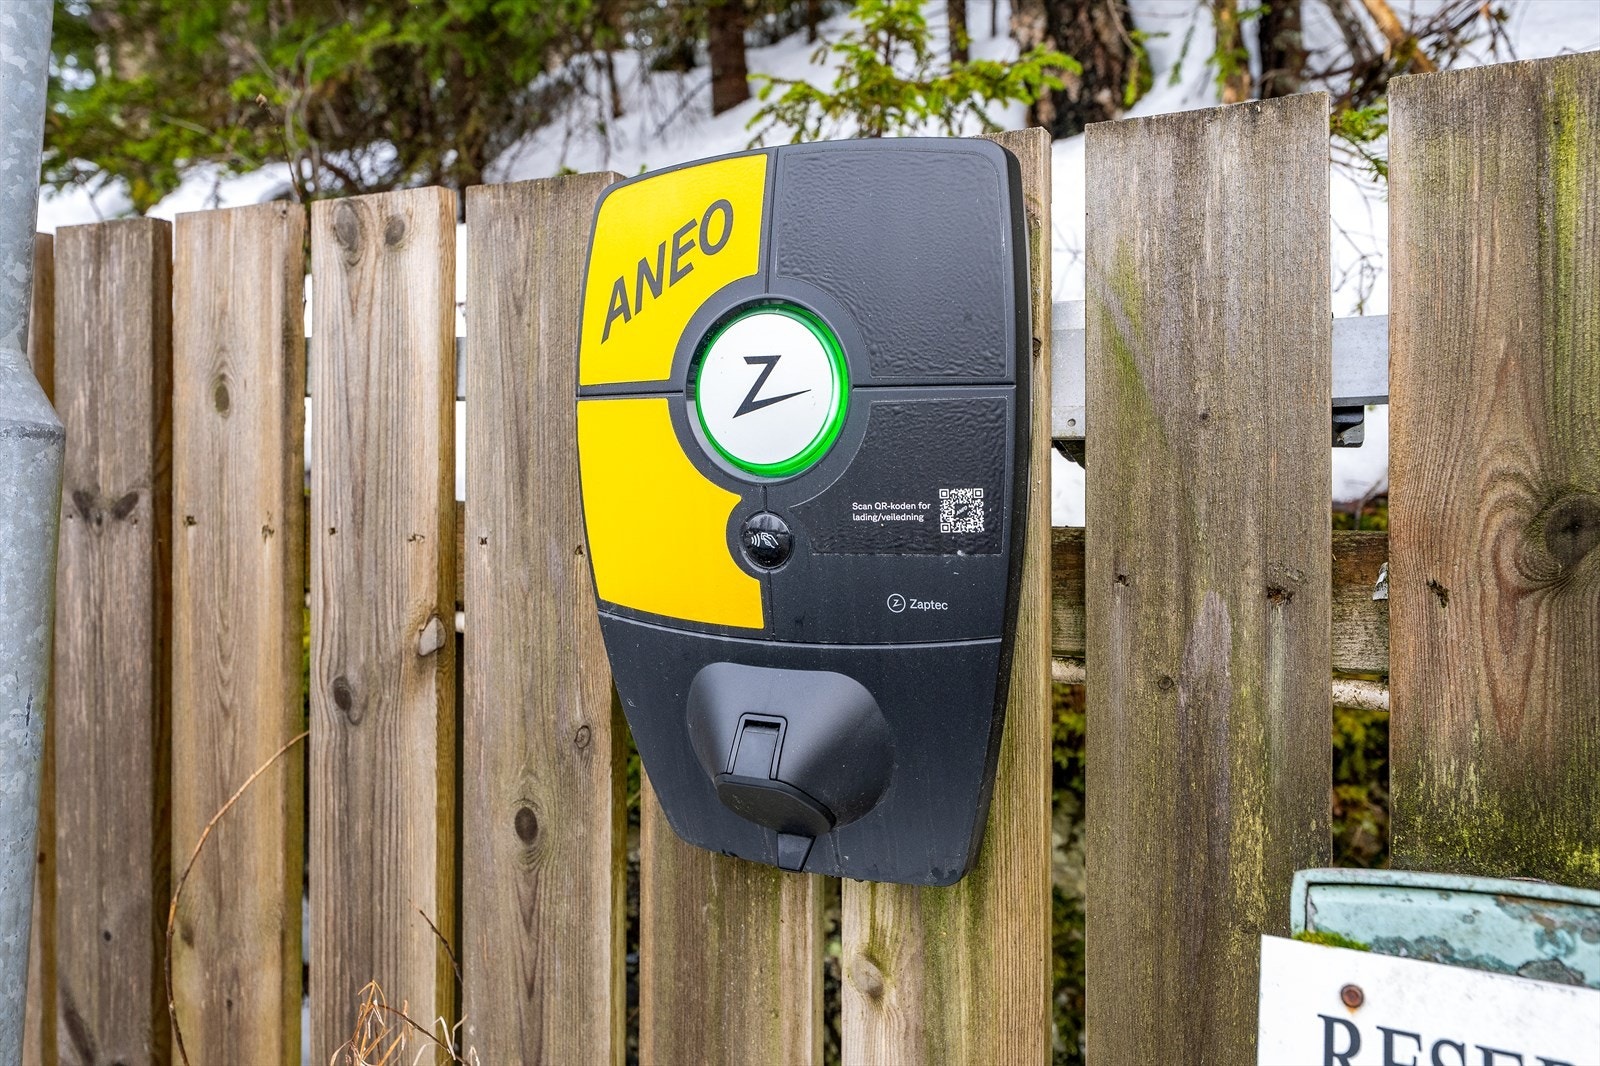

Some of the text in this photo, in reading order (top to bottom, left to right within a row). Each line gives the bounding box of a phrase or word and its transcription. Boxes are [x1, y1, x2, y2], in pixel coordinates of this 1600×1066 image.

[601, 199, 733, 344] ANEO
[852, 502, 931, 510] Scan QR-koden for
[852, 513, 924, 522] lading/veiledning
[909, 598, 948, 611] Zaptec
